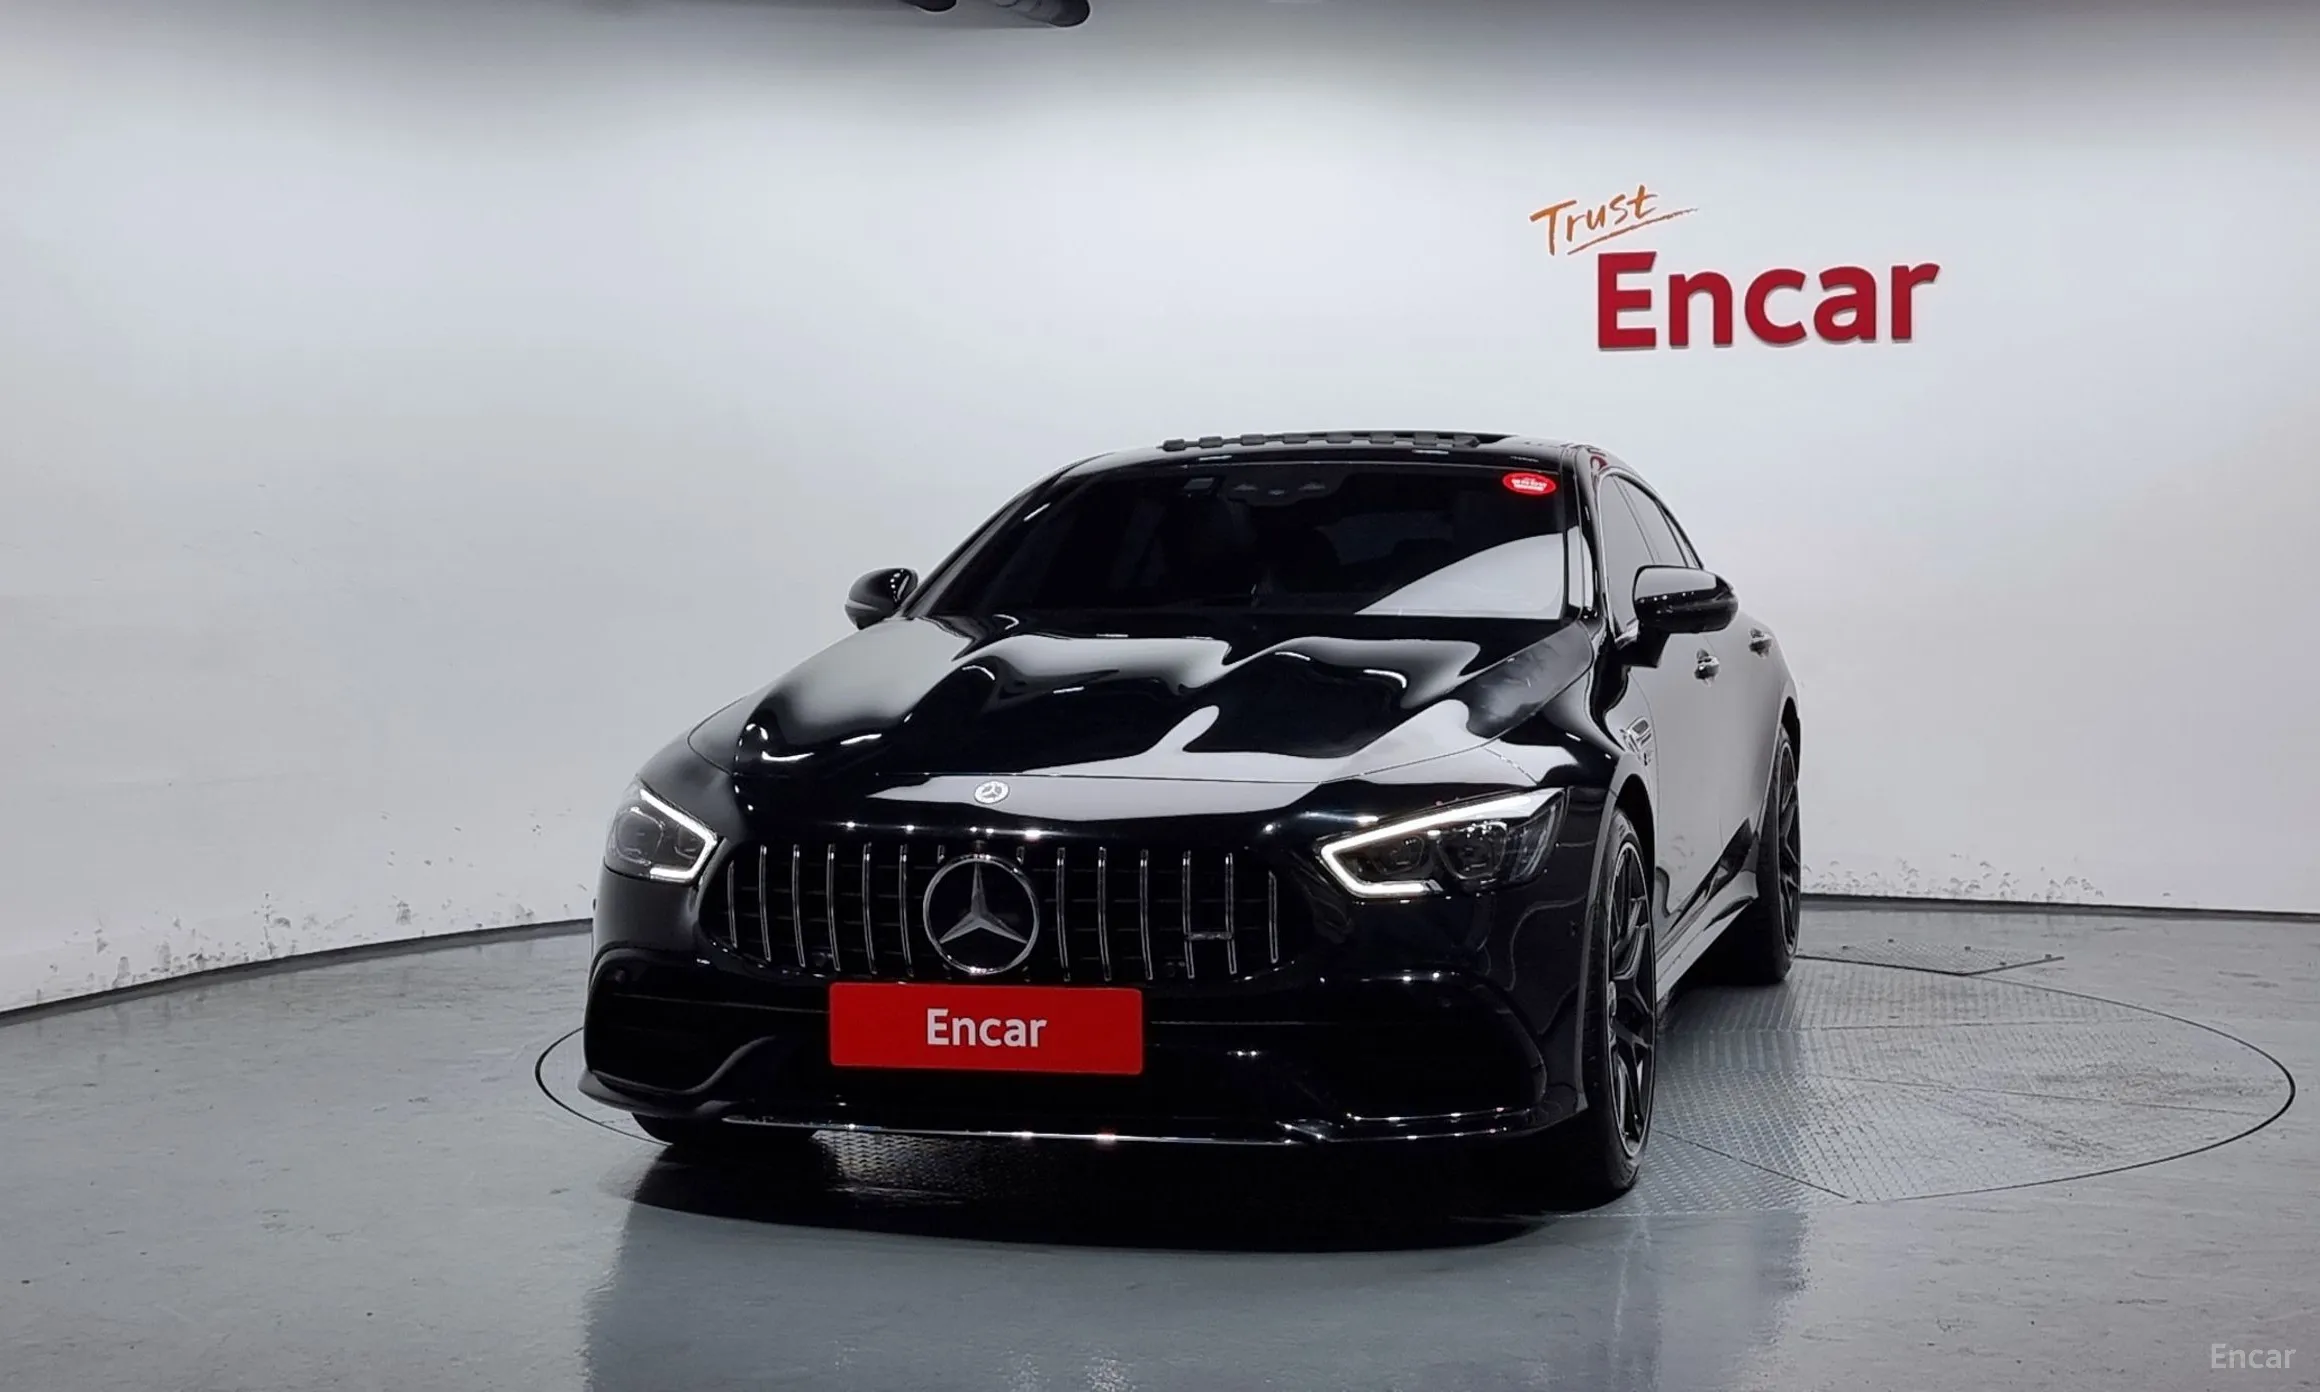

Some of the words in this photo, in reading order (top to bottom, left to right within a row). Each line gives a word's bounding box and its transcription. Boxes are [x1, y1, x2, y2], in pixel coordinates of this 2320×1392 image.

[1530, 185, 1657, 255] Trust
[1598, 251, 1940, 349] Encar
[926, 1008, 1047, 1048] Encar
